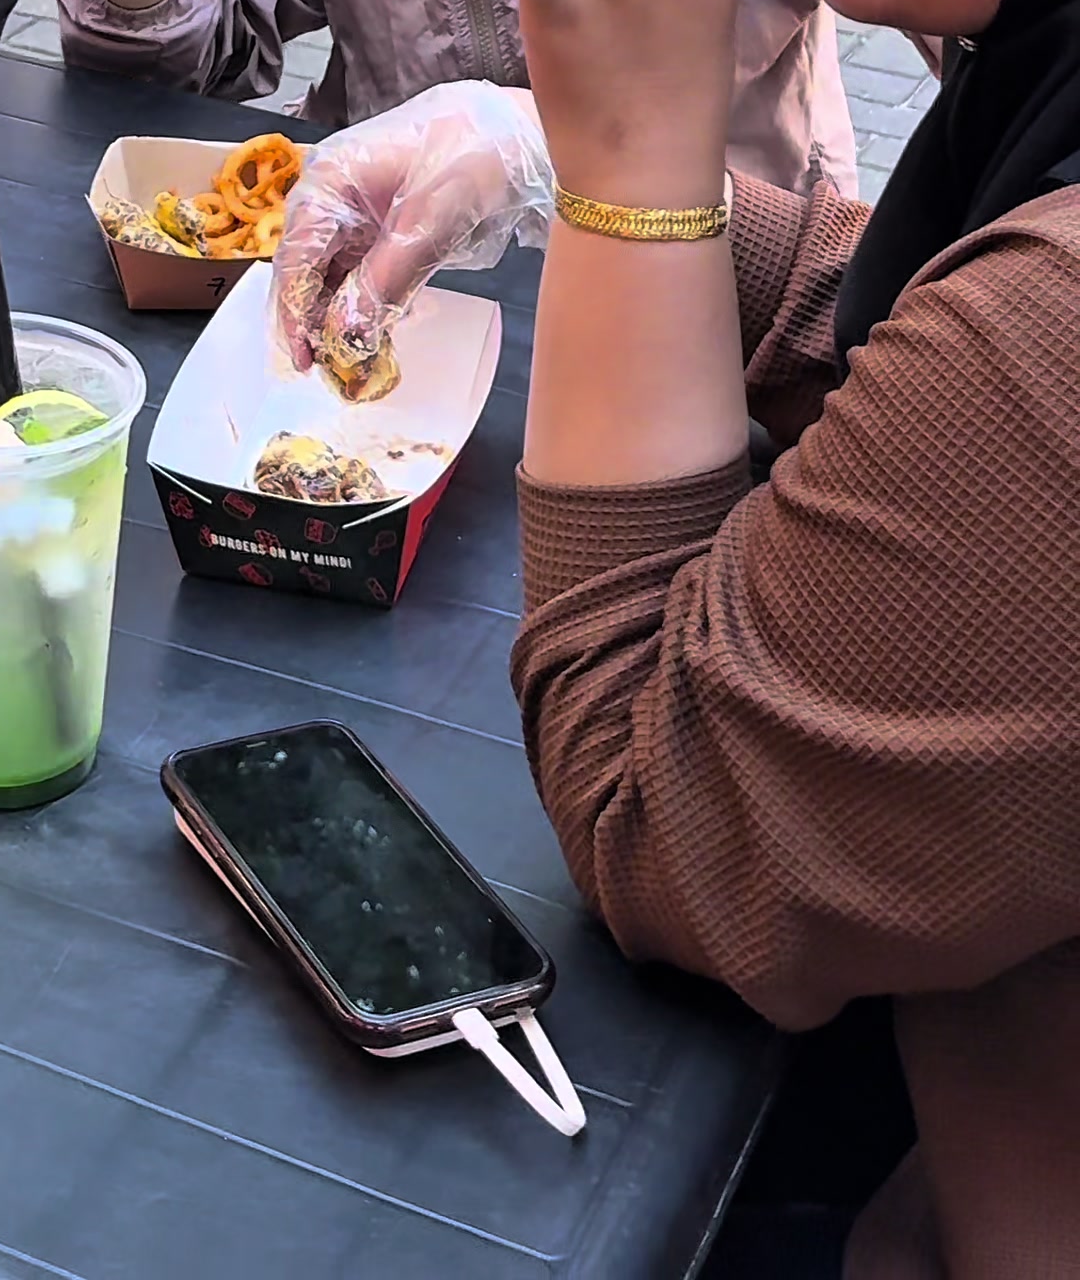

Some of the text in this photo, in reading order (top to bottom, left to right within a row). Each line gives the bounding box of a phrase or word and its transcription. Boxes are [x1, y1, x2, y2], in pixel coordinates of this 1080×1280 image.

[209, 533, 267, 556] BURGERS
[270, 545, 287, 560] ON
[290, 549, 309, 564] MY
